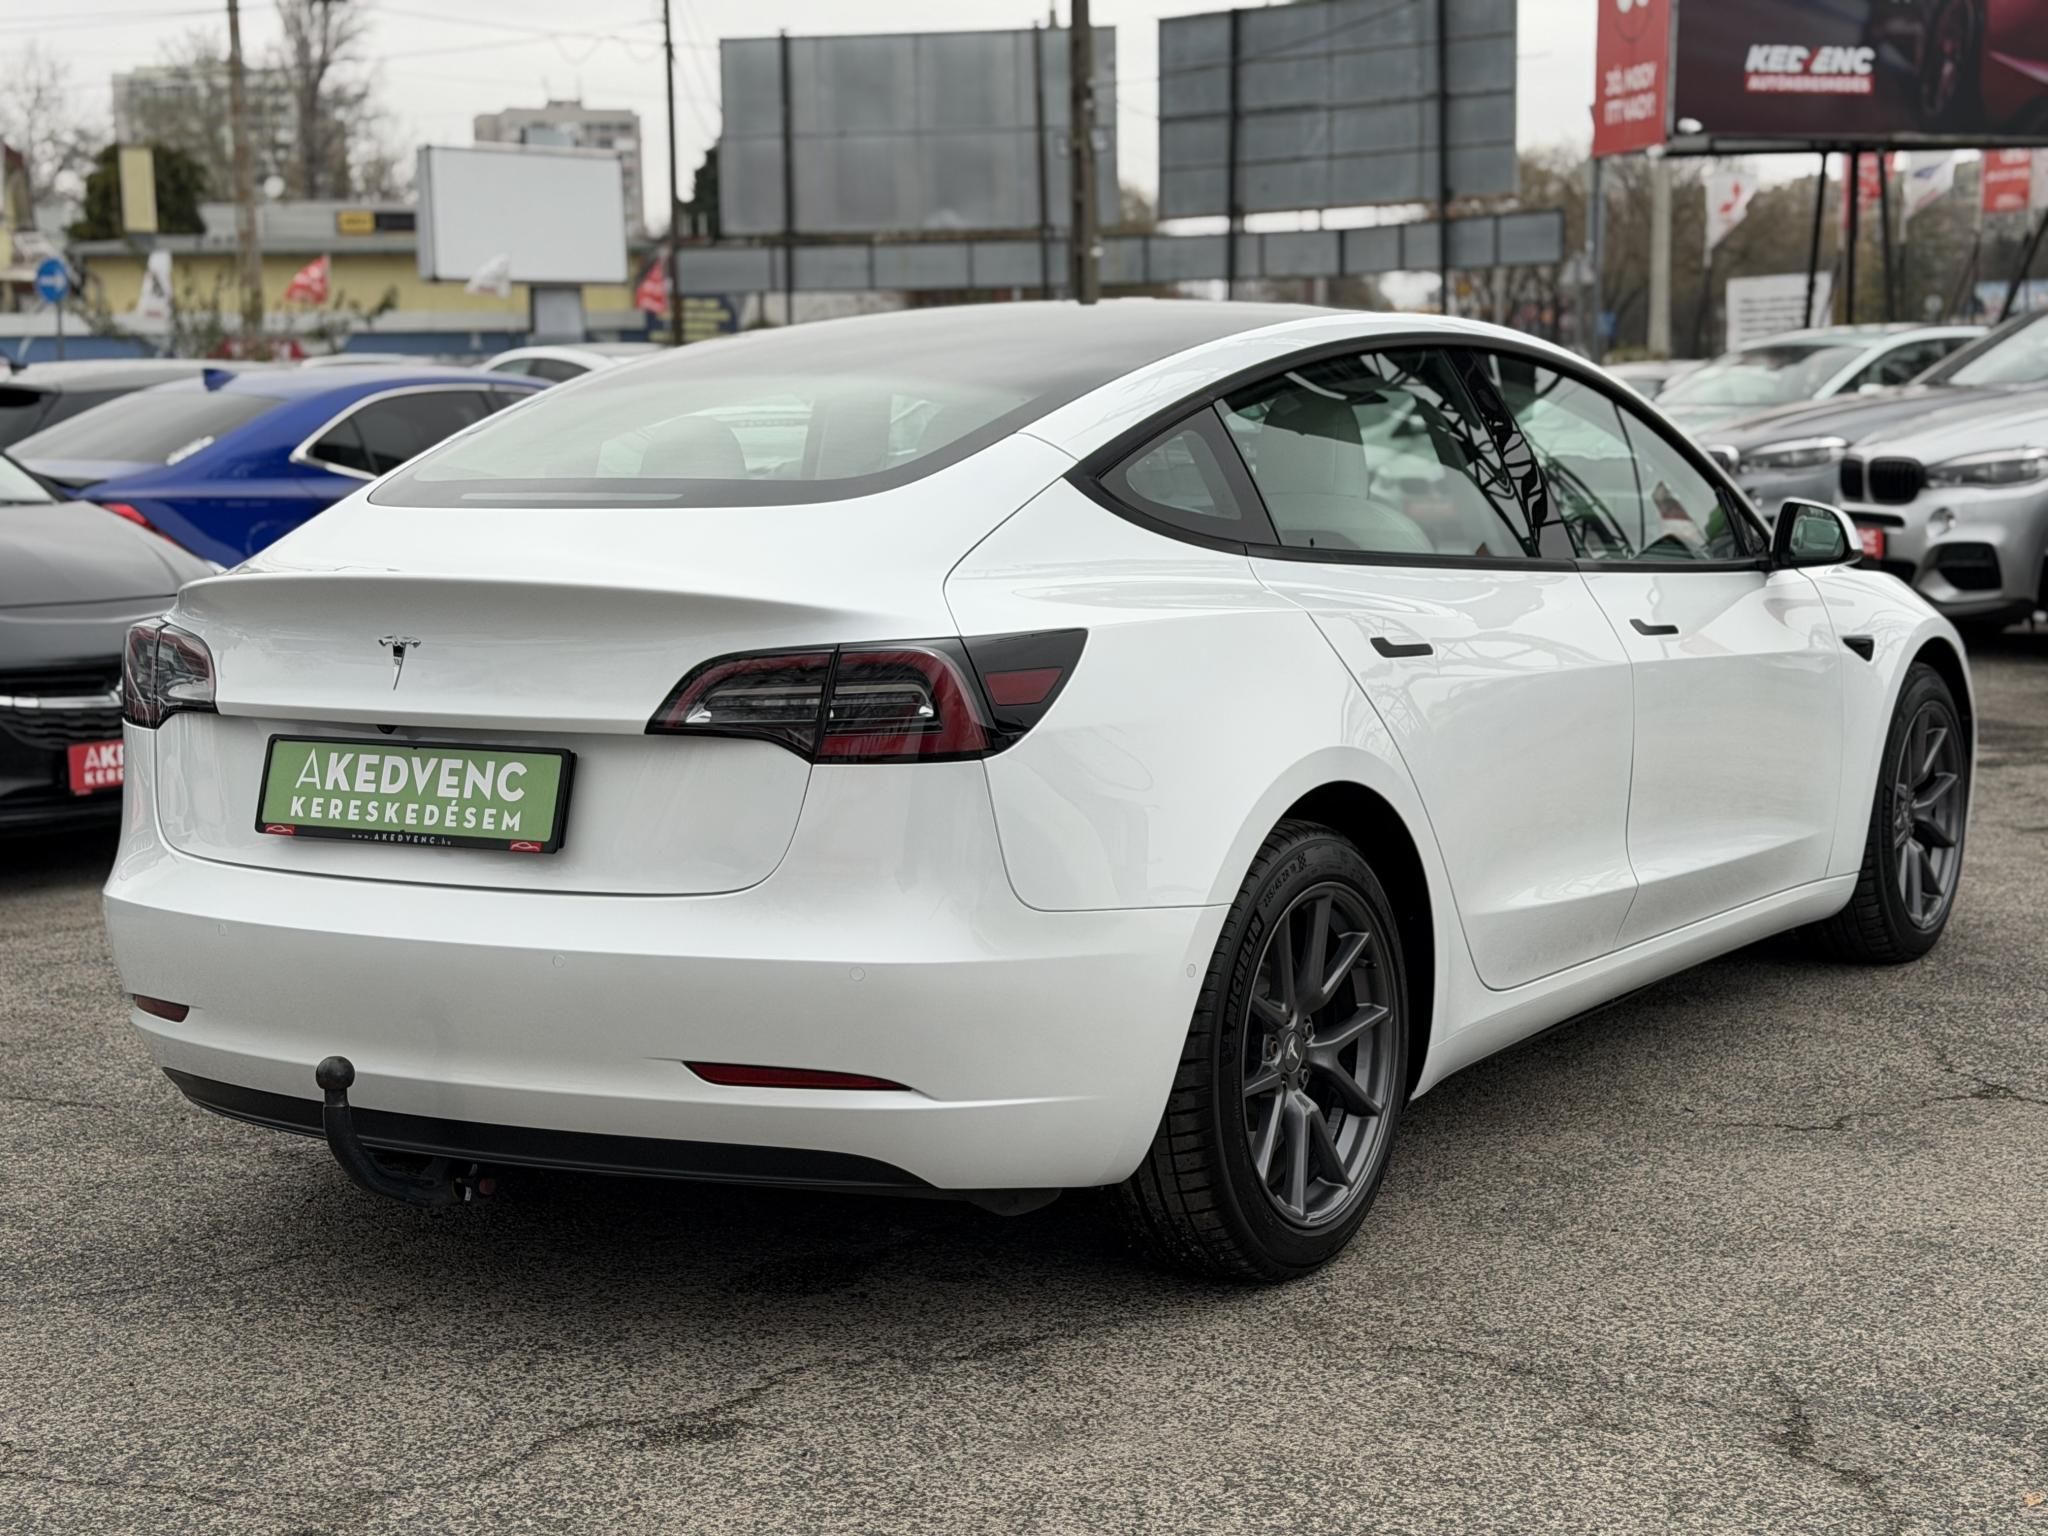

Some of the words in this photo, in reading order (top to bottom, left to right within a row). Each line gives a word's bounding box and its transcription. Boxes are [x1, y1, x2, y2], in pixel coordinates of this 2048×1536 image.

[295, 748, 528, 802] AKEDVENC
[290, 796, 521, 832] KERESKEDÉSEM
[1225, 913, 1264, 1028] MICHELIN
